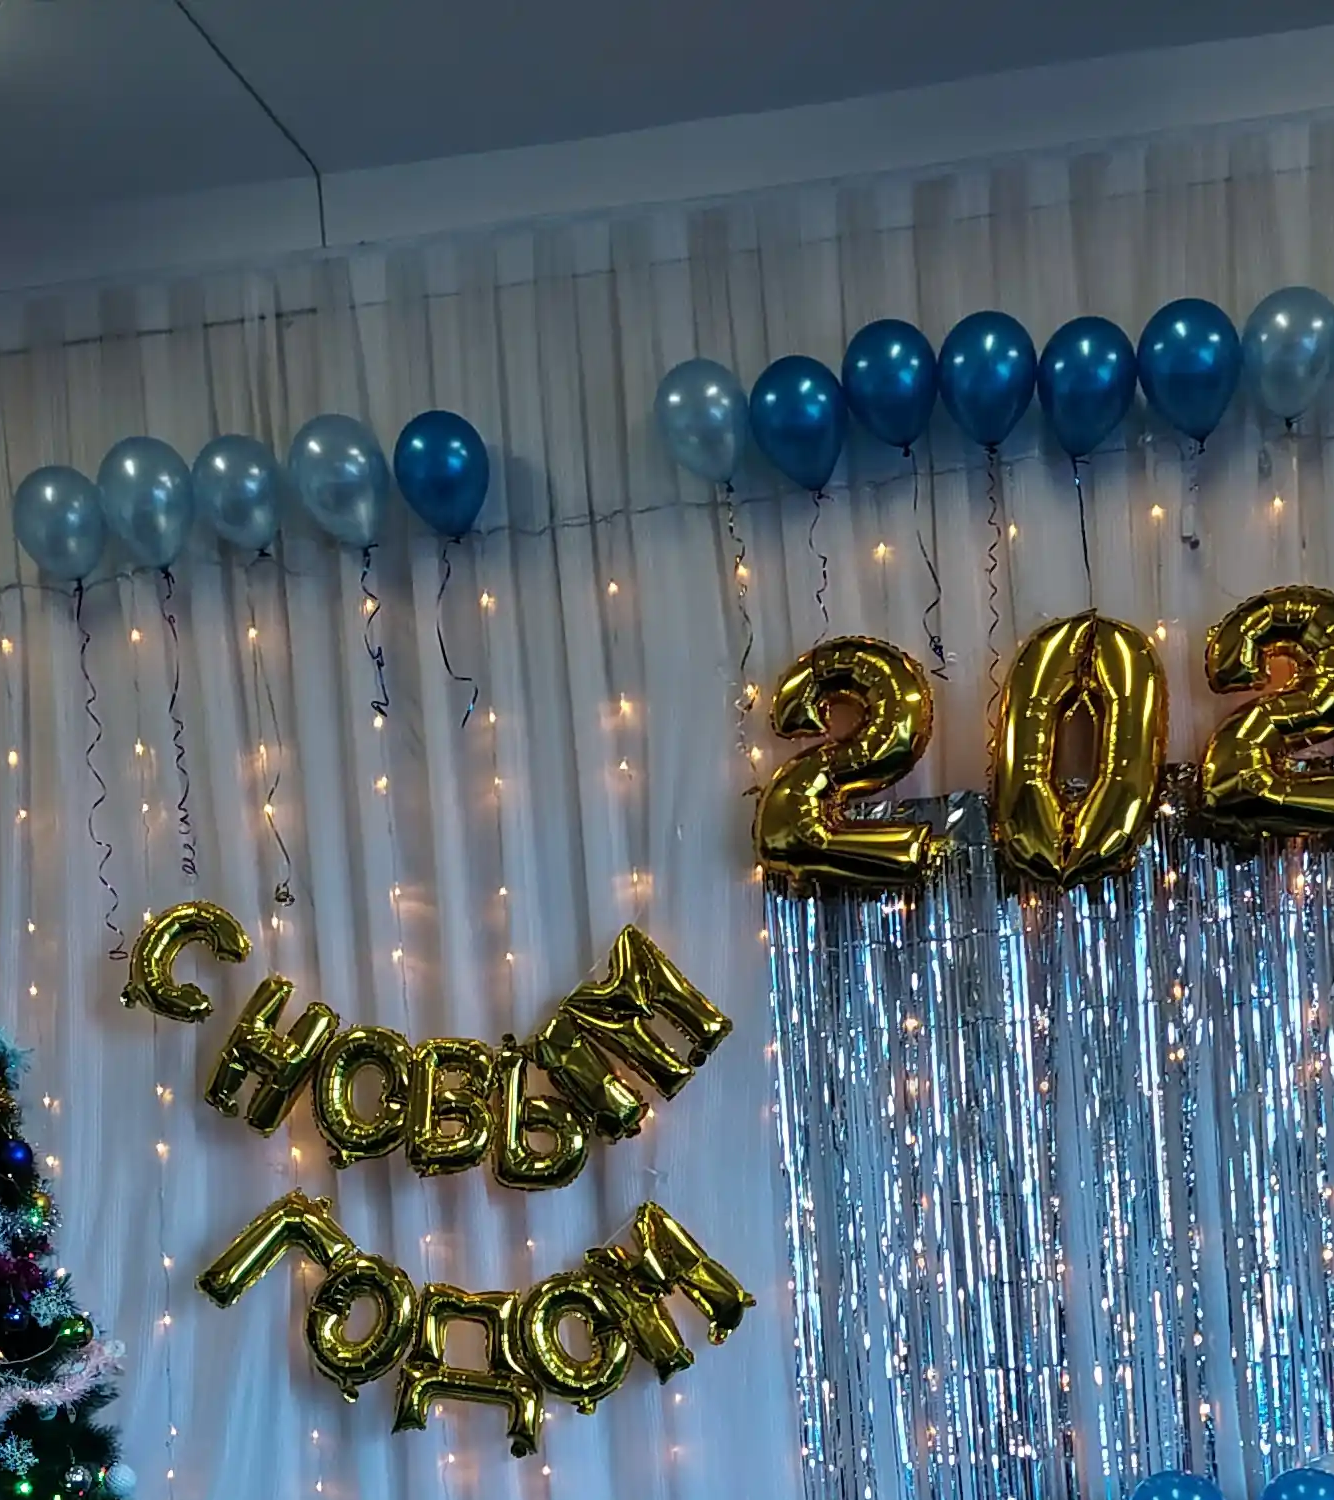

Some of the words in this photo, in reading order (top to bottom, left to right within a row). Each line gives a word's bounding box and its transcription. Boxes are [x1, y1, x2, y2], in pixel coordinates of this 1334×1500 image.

[120, 901, 253, 1022] С
[204, 925, 733, 1190] НОВЫМ
[195, 1190, 757, 1457] ГОДОМ
